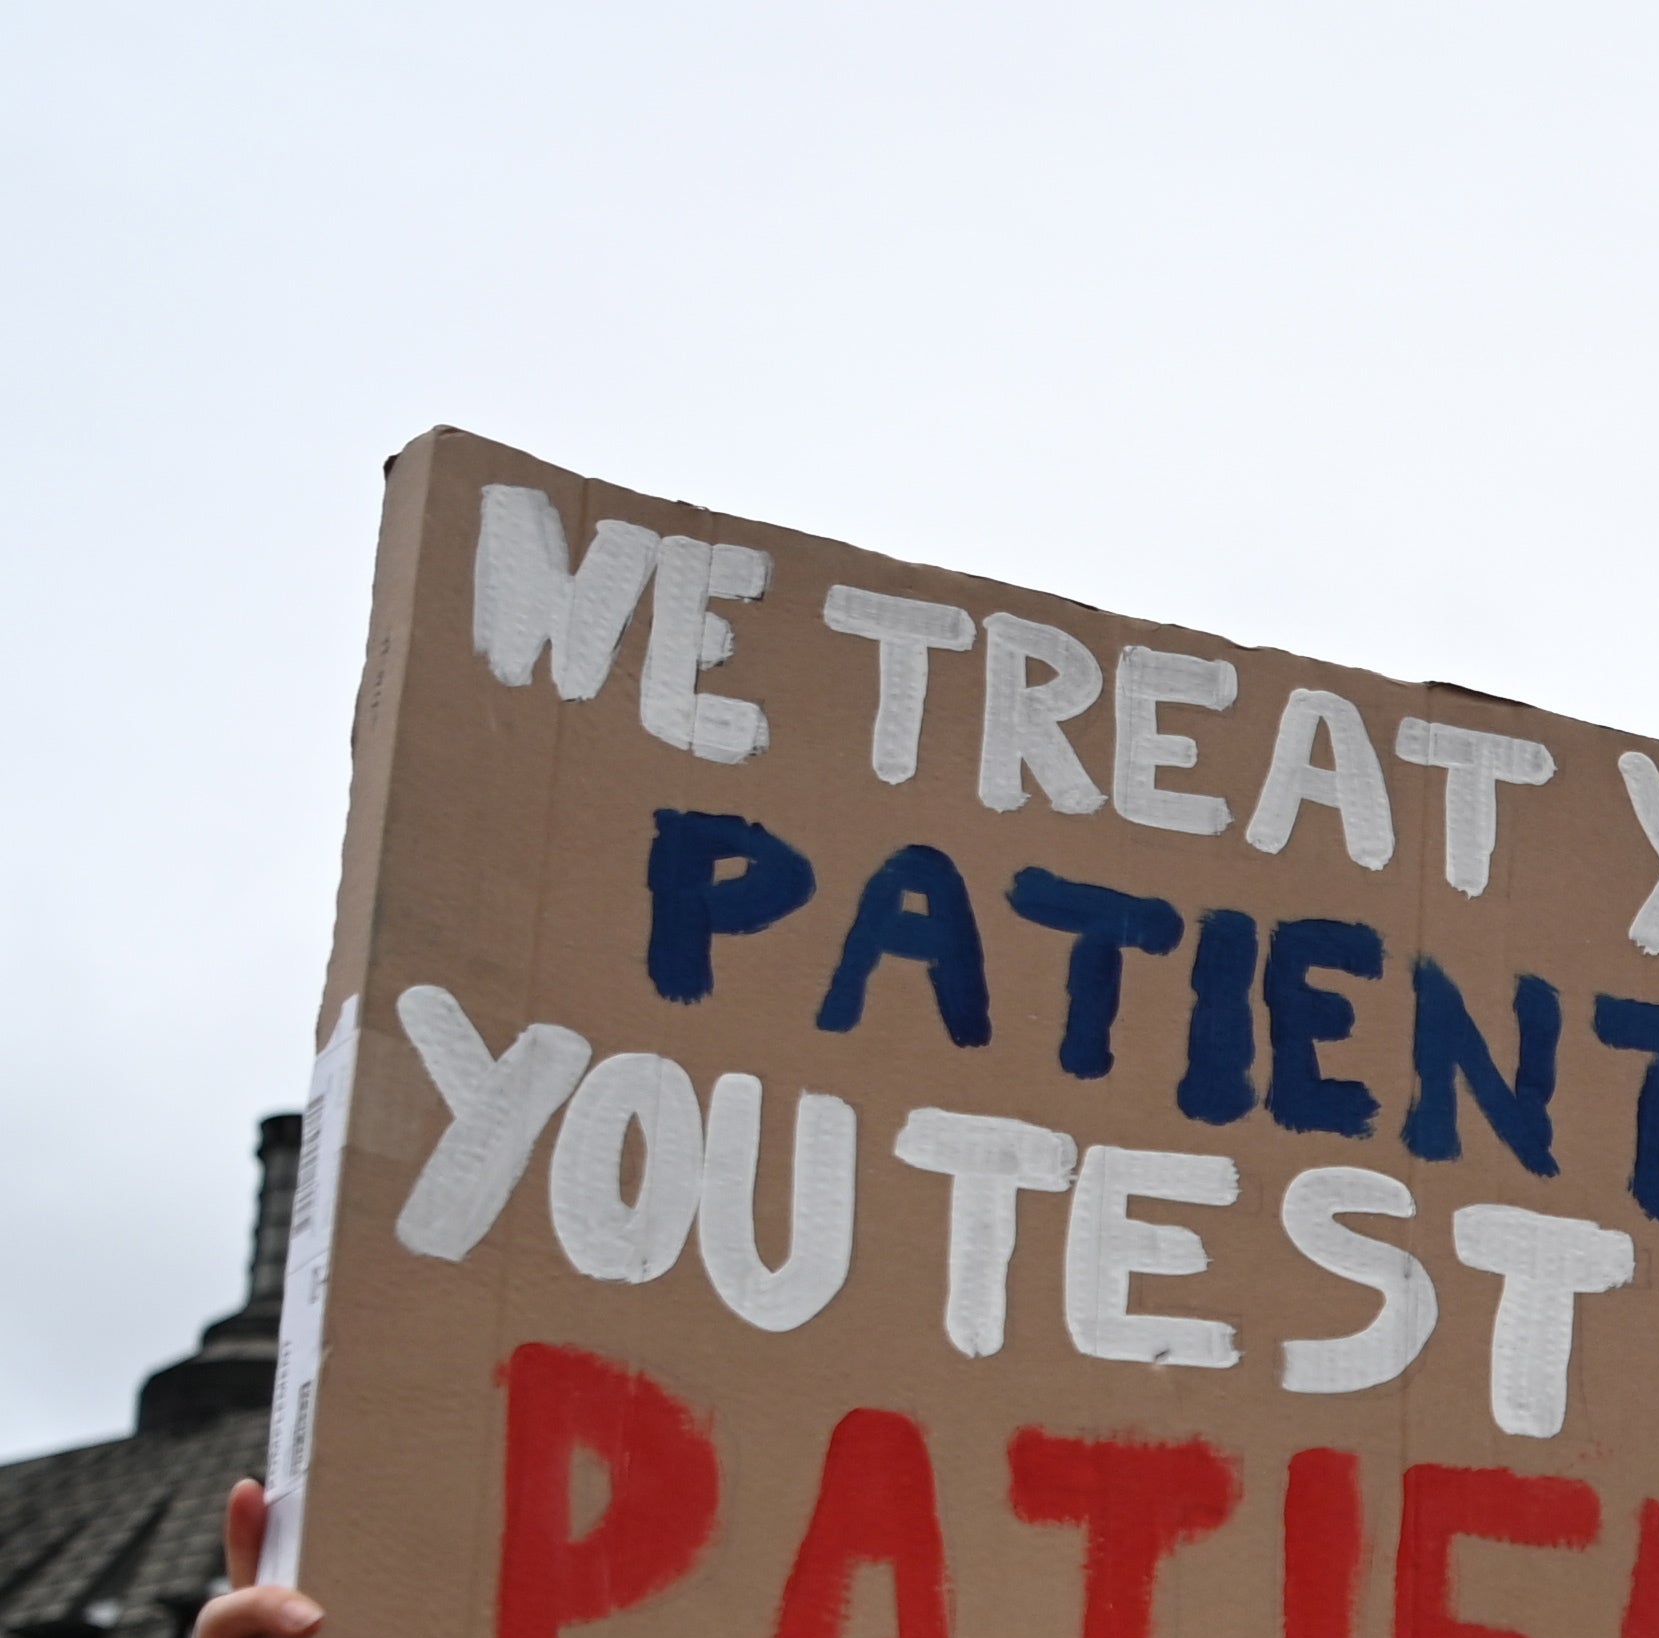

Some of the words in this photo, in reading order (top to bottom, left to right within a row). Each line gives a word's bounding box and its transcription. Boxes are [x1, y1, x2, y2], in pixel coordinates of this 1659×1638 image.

[474, 484, 773, 761] WE
[824, 583, 1556, 898] TREAT
[395, 985, 855, 1332] YOU
[894, 1107, 1635, 1437] TEST
